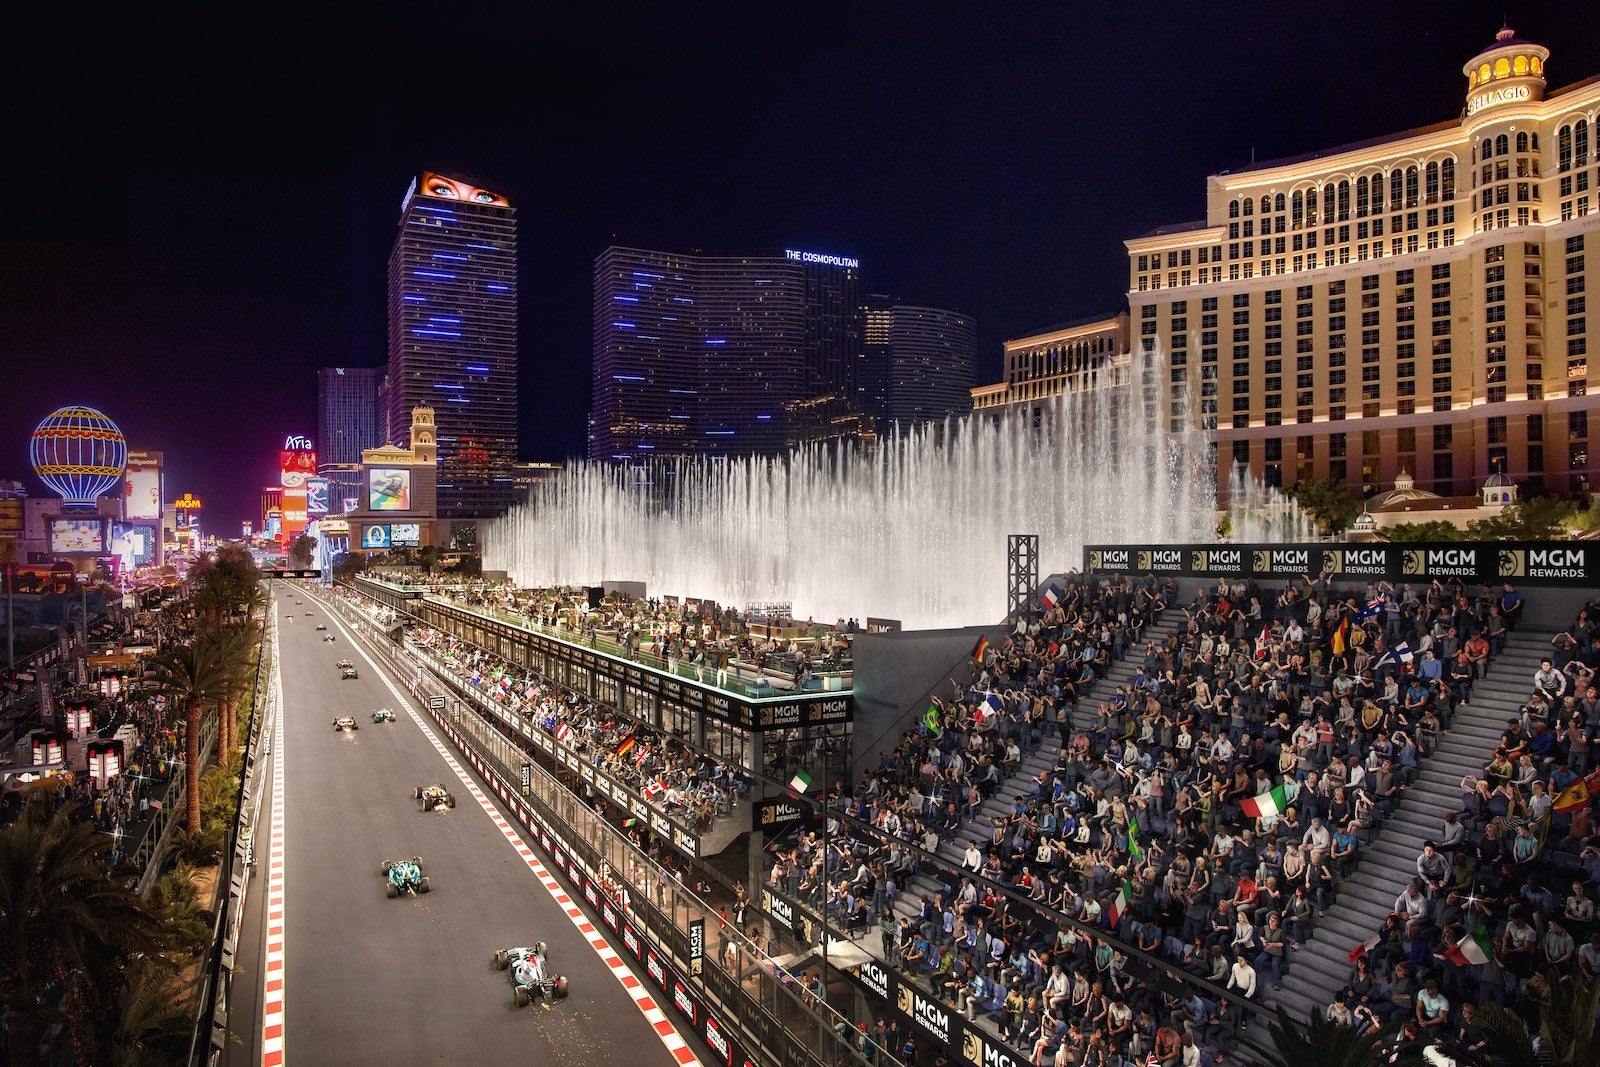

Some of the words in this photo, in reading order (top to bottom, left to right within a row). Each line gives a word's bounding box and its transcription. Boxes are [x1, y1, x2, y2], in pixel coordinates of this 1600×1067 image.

[1467, 87, 1530, 115] BELLAGIO
[785, 249, 801, 260] THE
[802, 252, 858, 268] COSMOPOLITAN
[285, 436, 312, 450] Aria
[175, 500, 201, 508] MGM
[1103, 550, 1129, 563] MGM
[1153, 550, 1181, 563] MGM
[1209, 550, 1241, 564] MGM
[1272, 550, 1308, 564] MGM
[1345, 550, 1386, 565] MGM
[1429, 550, 1476, 565] MGM
[1529, 550, 1585, 566] MGM
[1153, 563, 1181, 571] REWARDS
[1209, 564, 1241, 572] REWARDS
[1272, 565, 1309, 573] REWARDS
[1345, 566, 1386, 574] REWARDS
[1429, 567, 1476, 576] REWARDS
[1529, 568, 1585, 577] REWARDS
[714, 696, 729, 709] MGM
[823, 701, 847, 712] MGM
[774, 705, 799, 717] MGM
[822, 711, 847, 720] REWARDS
[774, 716, 800, 724] REWARDS
[771, 894, 793, 921] MGM
[771, 909, 793, 931] REWARDS
[861, 962, 888, 989] MGM
[860, 974, 888, 1000] REWARDS
[915, 994, 949, 1032] MGM
[915, 1012, 949, 1045] REWARDS
